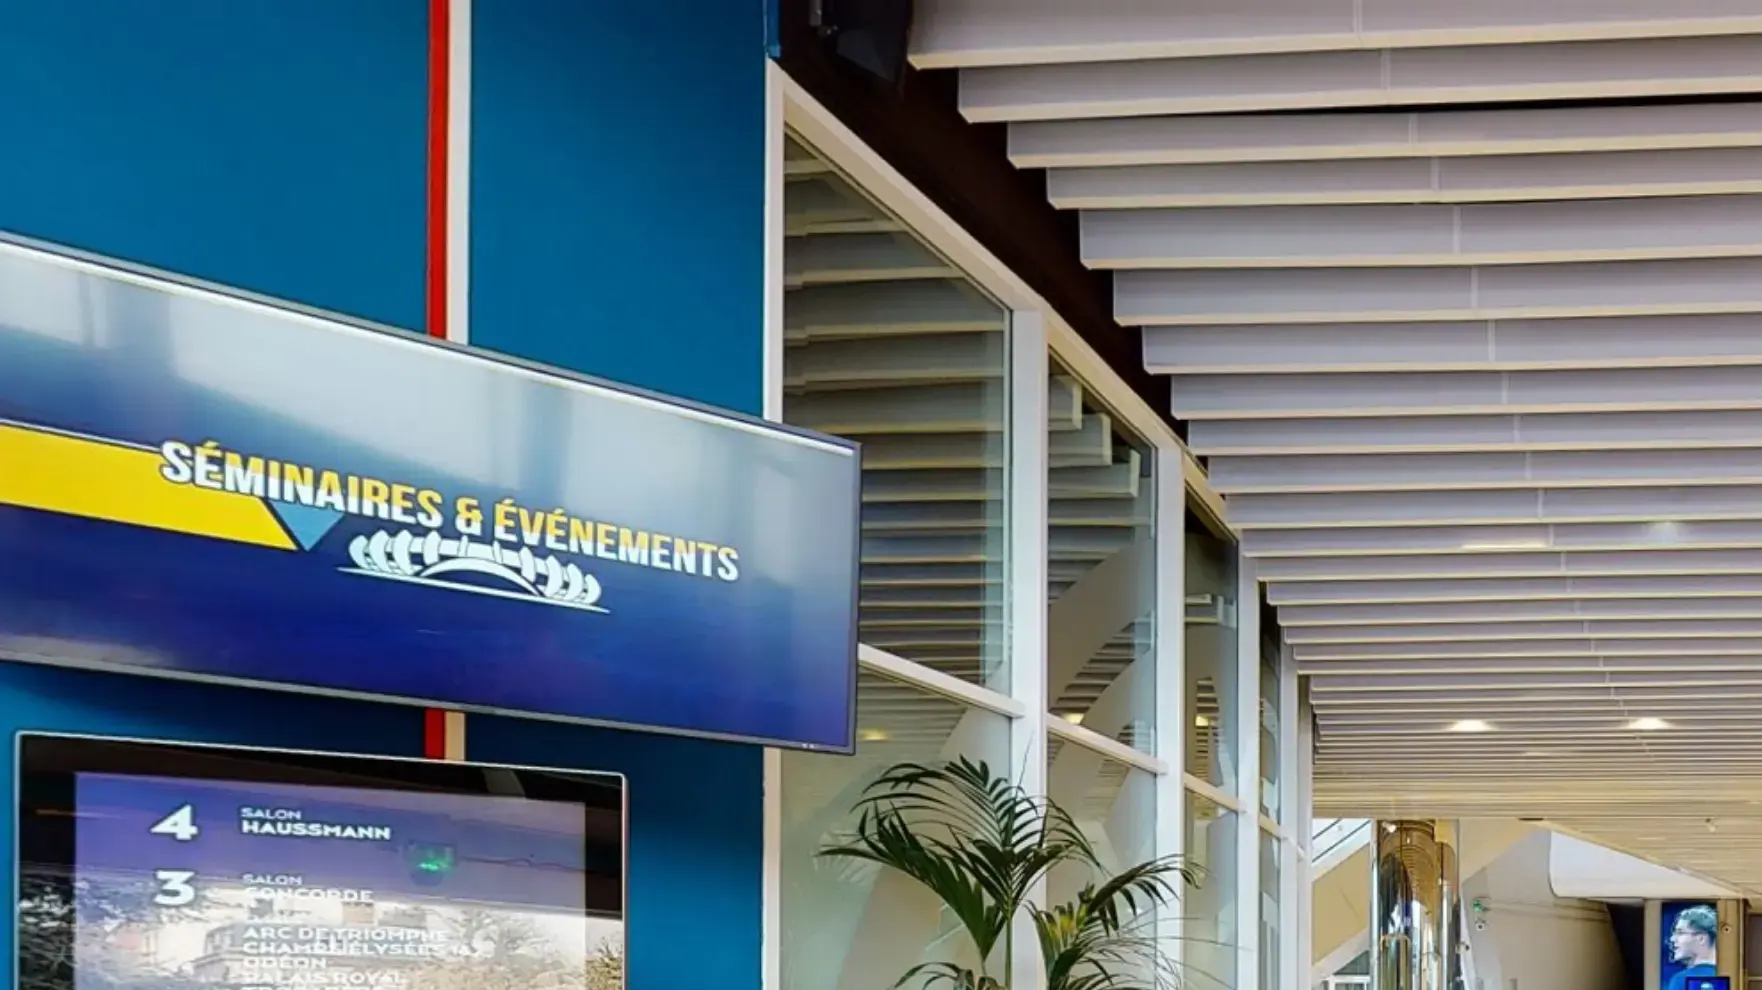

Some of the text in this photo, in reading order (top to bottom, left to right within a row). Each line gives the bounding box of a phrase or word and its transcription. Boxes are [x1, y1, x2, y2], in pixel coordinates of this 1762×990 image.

[158, 439, 739, 581] SÉMINAIRES & ÉVÉNEMENTS
[150, 804, 198, 840] 4
[241, 807, 302, 820] SALON
[242, 820, 391, 840] HAUSSMANN
[154, 870, 195, 905] 3
[243, 873, 303, 885] SALON
[243, 887, 374, 902] CONCORDE
[243, 927, 293, 939] ARC
